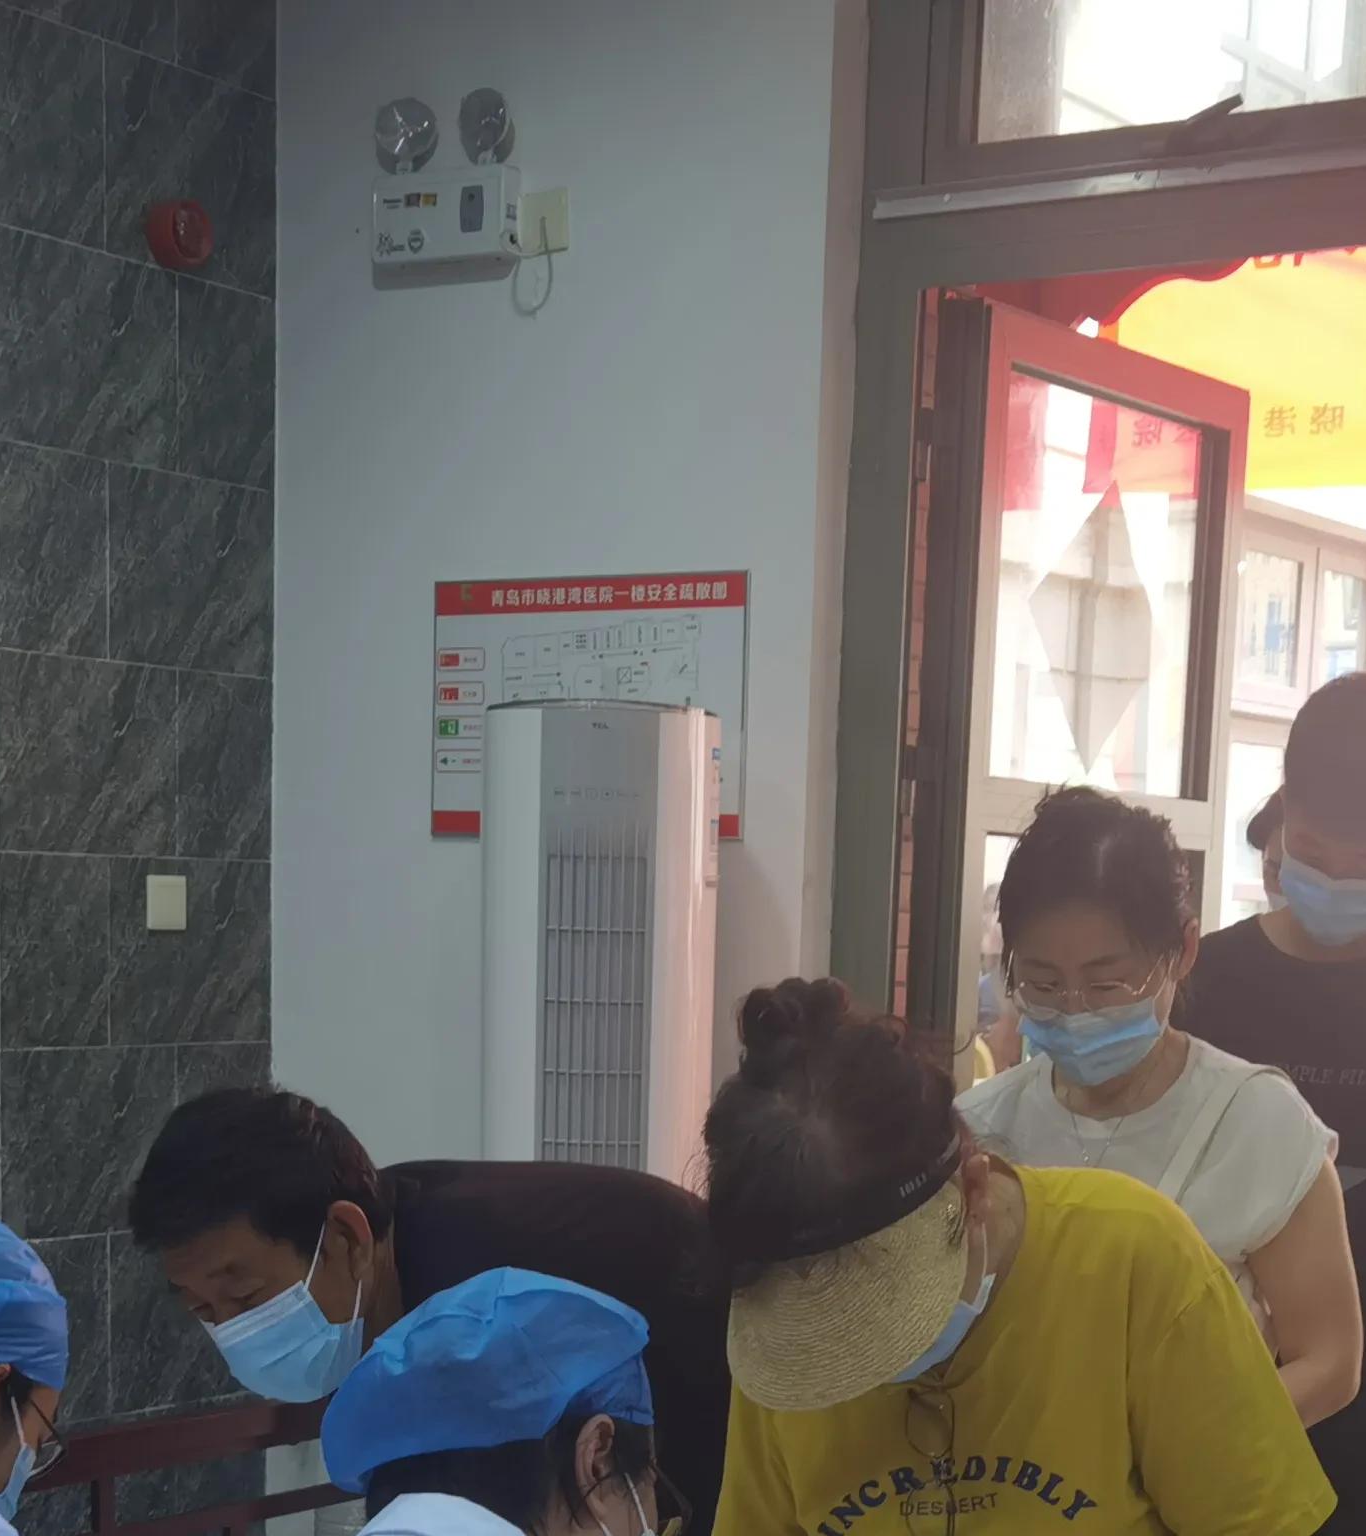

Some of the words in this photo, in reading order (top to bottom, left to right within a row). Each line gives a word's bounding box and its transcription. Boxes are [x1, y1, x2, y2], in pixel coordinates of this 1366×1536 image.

[491, 581, 728, 608] 青岛市晓港湾医院一楼安全疏散图
